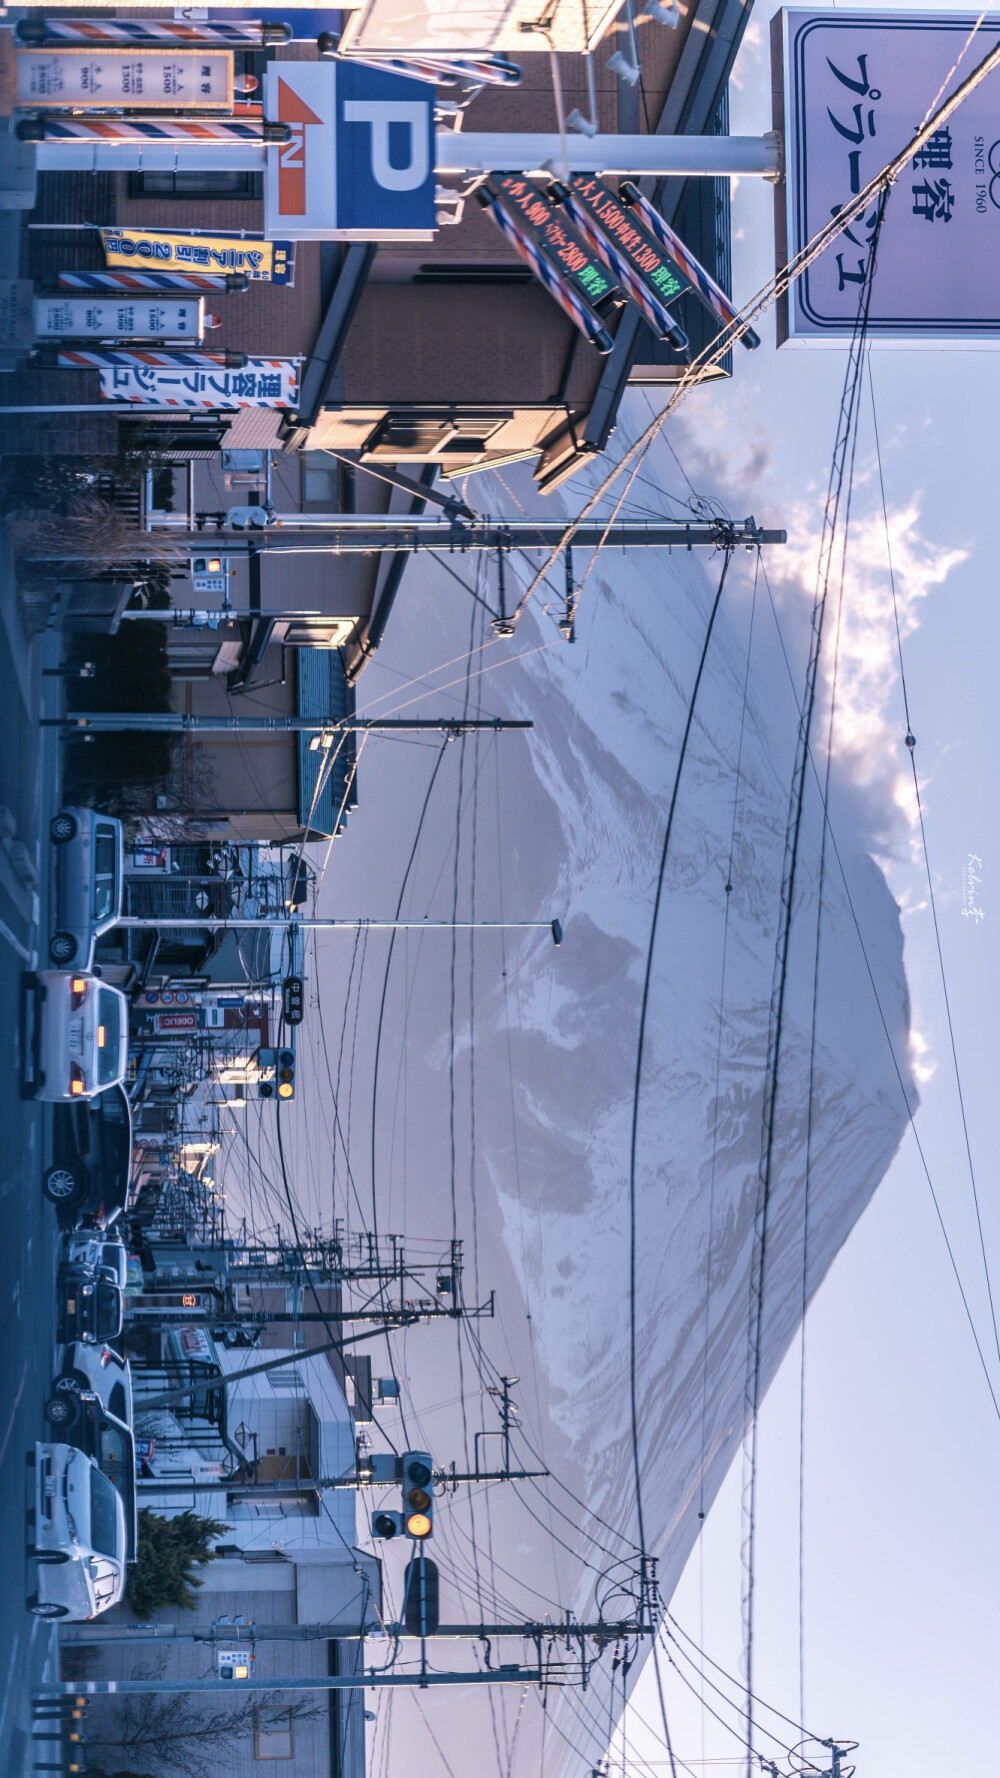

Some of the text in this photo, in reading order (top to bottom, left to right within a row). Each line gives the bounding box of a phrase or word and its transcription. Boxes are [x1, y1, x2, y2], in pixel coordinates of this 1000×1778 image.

[201, 66, 211, 94] 理容
[280, 122, 305, 168] IN
[344, 100, 430, 191] P
[826, 54, 881, 291] プラージュ
[911, 126, 954, 223] 理容
[974, 136, 987, 213] SINCE 1960
[274, 250, 286, 274] 理容
[524, 202, 551, 226] 900
[557, 242, 589, 272] 2800
[578, 265, 608, 296] 理容
[595, 200, 626, 229] 1500
[631, 243, 661, 272] 1300
[651, 266, 680, 297] 理容
[178, 309, 186, 330] 理容
[113, 368, 282, 397] 理容プラージュ
[164, 1018, 194, 1026] ODELIC
